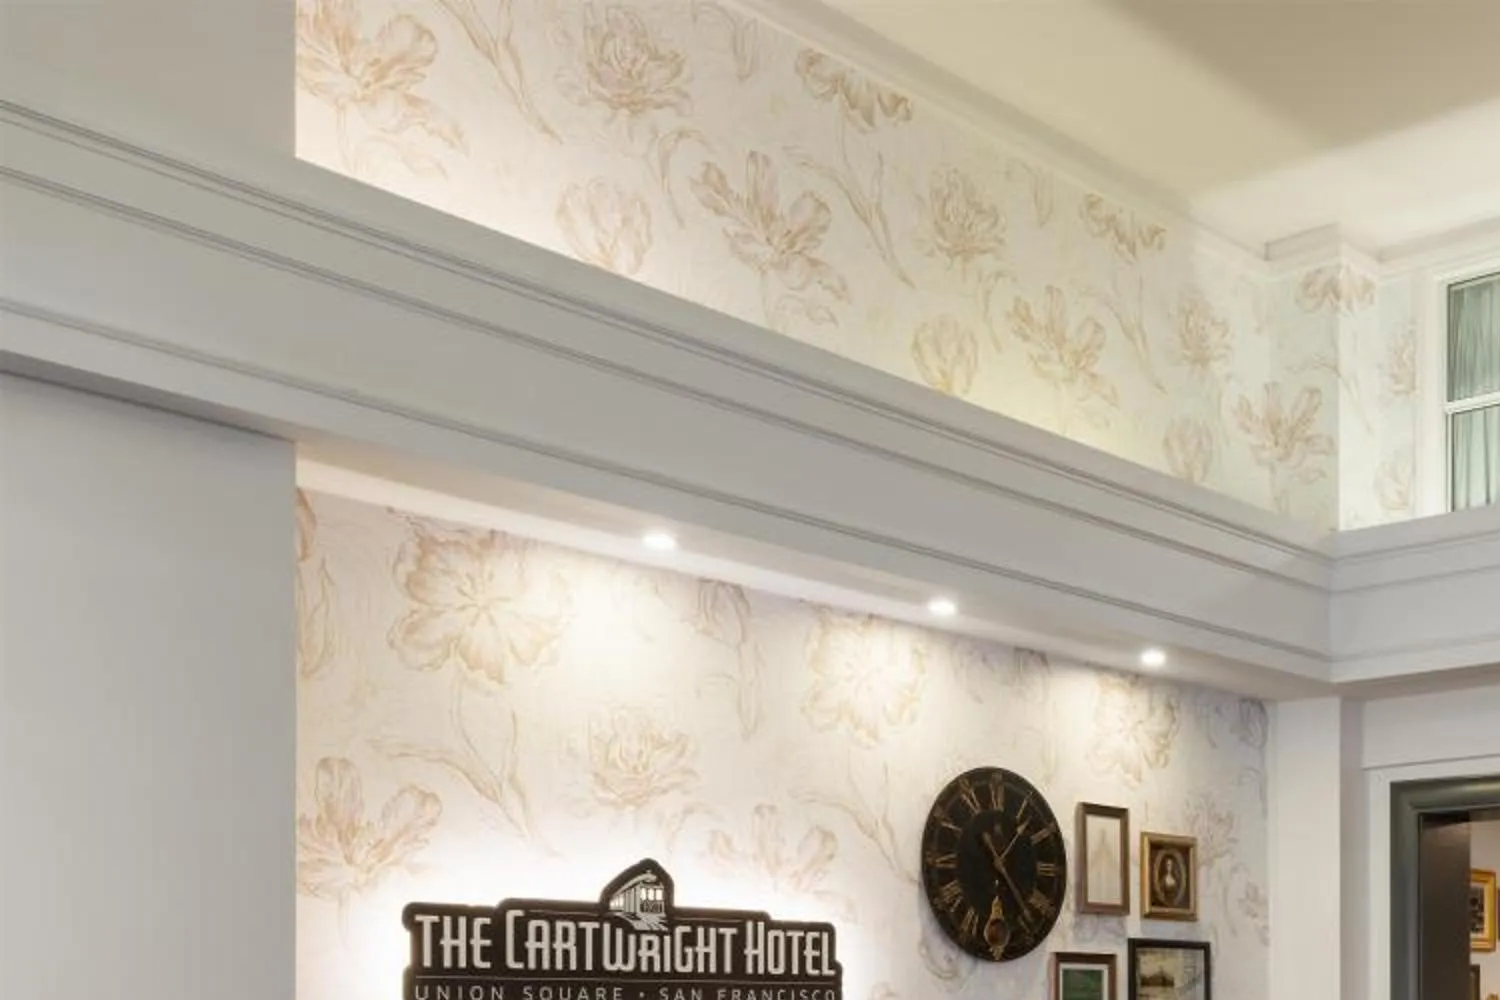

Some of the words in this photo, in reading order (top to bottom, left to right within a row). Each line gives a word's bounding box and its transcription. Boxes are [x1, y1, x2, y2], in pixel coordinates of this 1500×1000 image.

[414, 914, 493, 969] THE
[505, 909, 738, 973] CARTWRIGHT
[744, 920, 836, 976] HOTEL
